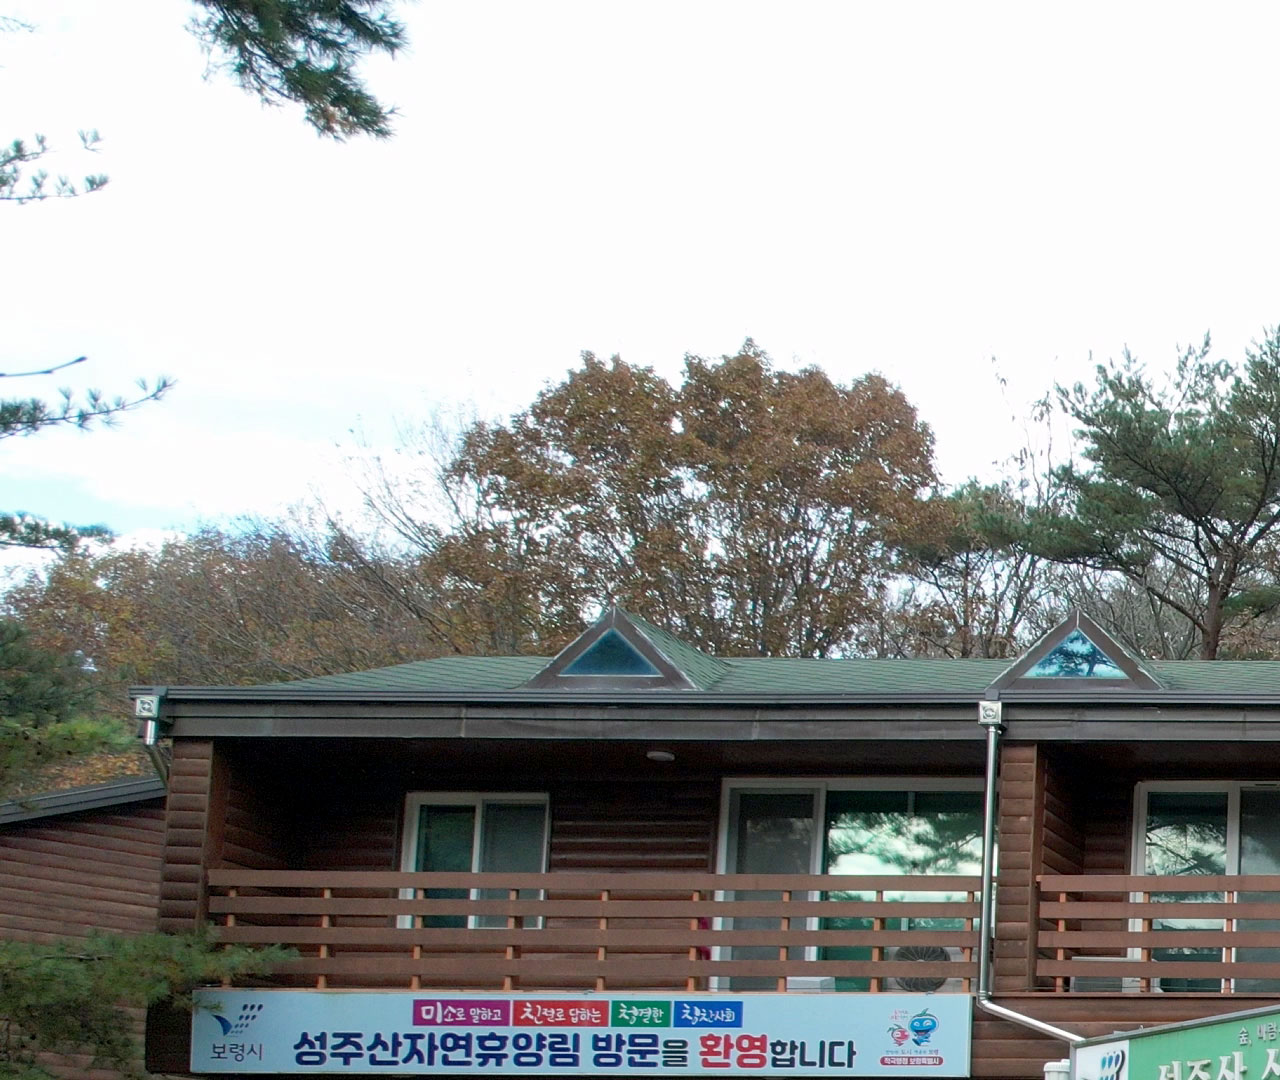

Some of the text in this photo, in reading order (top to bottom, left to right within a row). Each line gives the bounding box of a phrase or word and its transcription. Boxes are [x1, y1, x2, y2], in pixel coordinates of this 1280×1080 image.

[420, 1002, 503, 1024] 미소로 말하고
[520, 1002, 602, 1024] 친절로 답하는
[618, 1003, 665, 1024] 청결한
[681, 1003, 736, 1025] 칭찬사회
[210, 1043, 264, 1063] 보령시
[293, 1031, 857, 1069] 성주산자연휴양림 방문을 환영합니다
